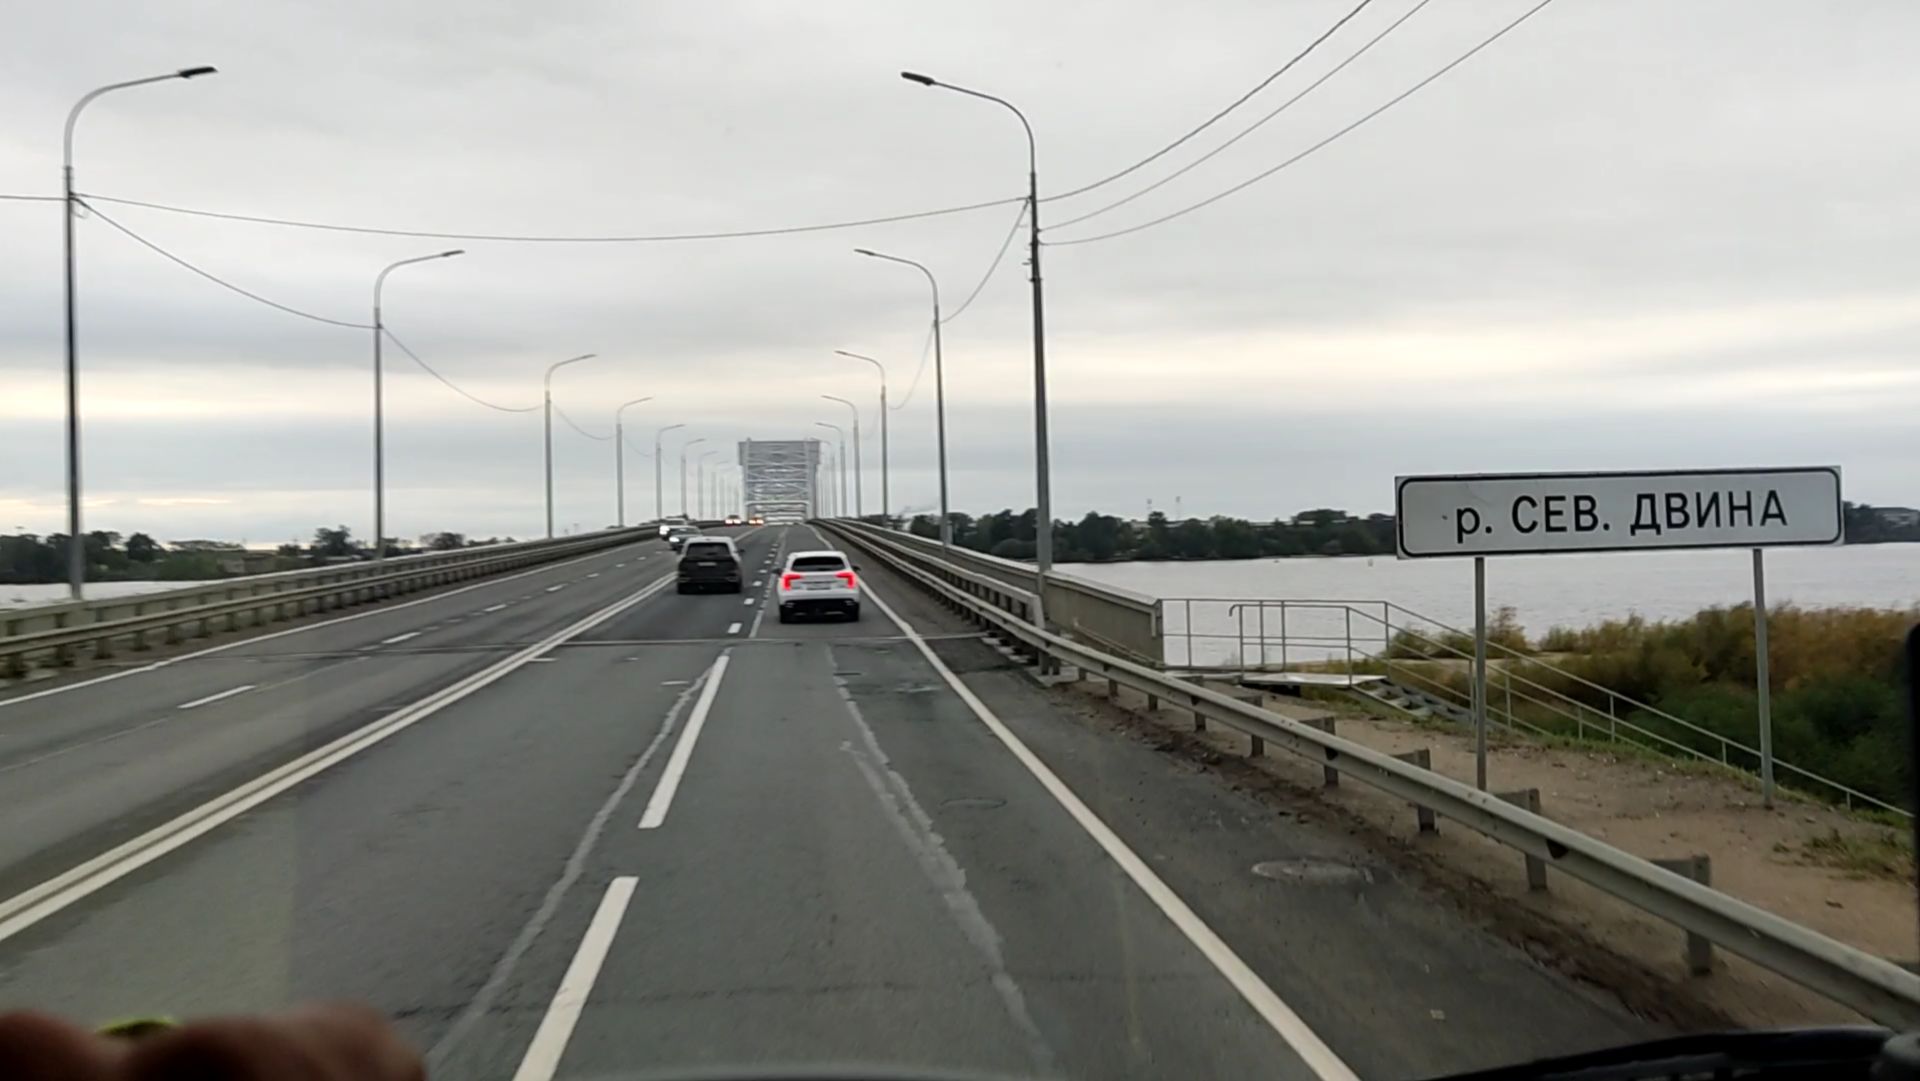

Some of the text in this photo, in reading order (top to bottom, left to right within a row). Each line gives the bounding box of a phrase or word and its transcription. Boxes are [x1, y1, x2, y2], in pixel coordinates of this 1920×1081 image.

[1456, 490, 1787, 544] р. СЕВ. ДВИНА
